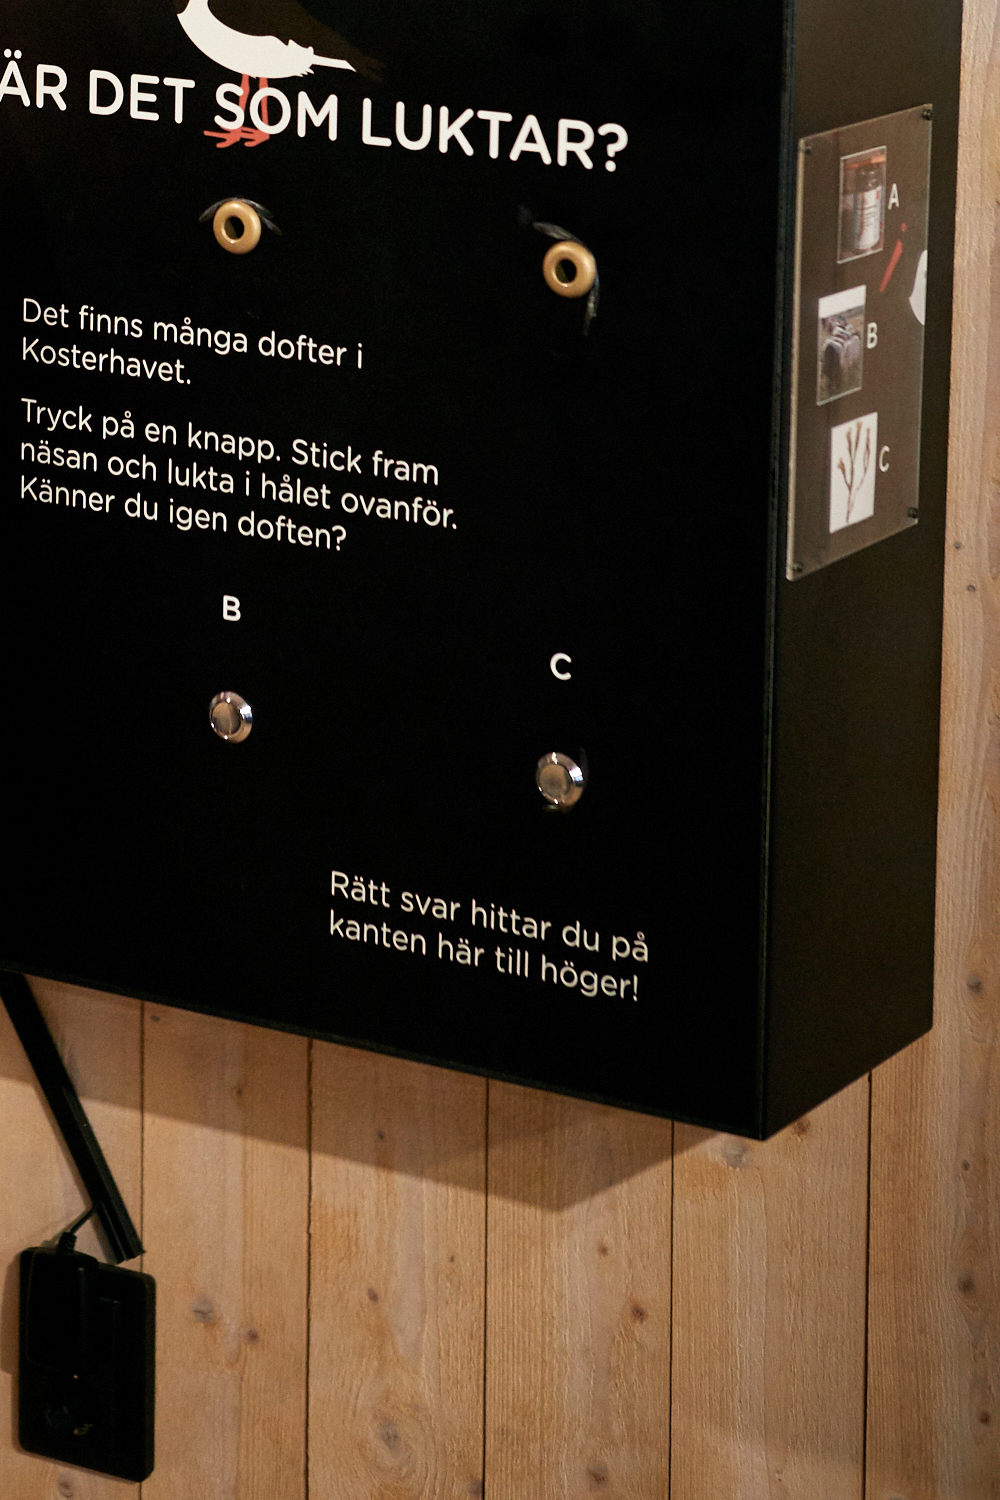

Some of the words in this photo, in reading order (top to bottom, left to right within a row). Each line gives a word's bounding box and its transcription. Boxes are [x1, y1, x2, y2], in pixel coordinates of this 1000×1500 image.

[87, 68, 196, 125] DET
[213, 81, 339, 143] SOM
[360, 96, 630, 173] LUKTAR?
[887, 183, 900, 211] A
[22, 296, 70, 329] Det
[78, 303, 144, 339] finns
[152, 316, 249, 356] många
[257, 330, 348, 368] dofter
[356, 341, 364, 370] i
[22, 335, 192, 386] Kosterhavet.
[866, 321, 879, 350] B
[20, 396, 93, 434] Tryck
[102, 410, 136, 440] på
[143, 421, 178, 446] en
[186, 420, 282, 465] knapp.
[290, 437, 363, 475] Stick
[371, 449, 440, 487] fram
[878, 444, 891, 474] C
[20, 438, 99, 474] näsan
[106, 453, 158, 483] och
[167, 457, 235, 495] lukta
[244, 470, 251, 497] i
[260, 472, 332, 511] hålet
[340, 492, 458, 531] ovanför.
[20, 474, 116, 514] Känner
[123, 491, 159, 522] du
[168, 497, 229, 533] igen
[236, 510, 348, 553] doften?
[221, 594, 242, 623] B
[549, 651, 573, 682] C
[330, 869, 391, 909] Rätt
[400, 890, 461, 923] svar
[471, 898, 552, 942] hittar
[561, 920, 600, 953] du
[612, 931, 649, 963] på
[329, 908, 427, 956] kanten
[438, 931, 486, 968] här
[494, 946, 530, 979] till
[541, 953, 639, 1003] höger!
